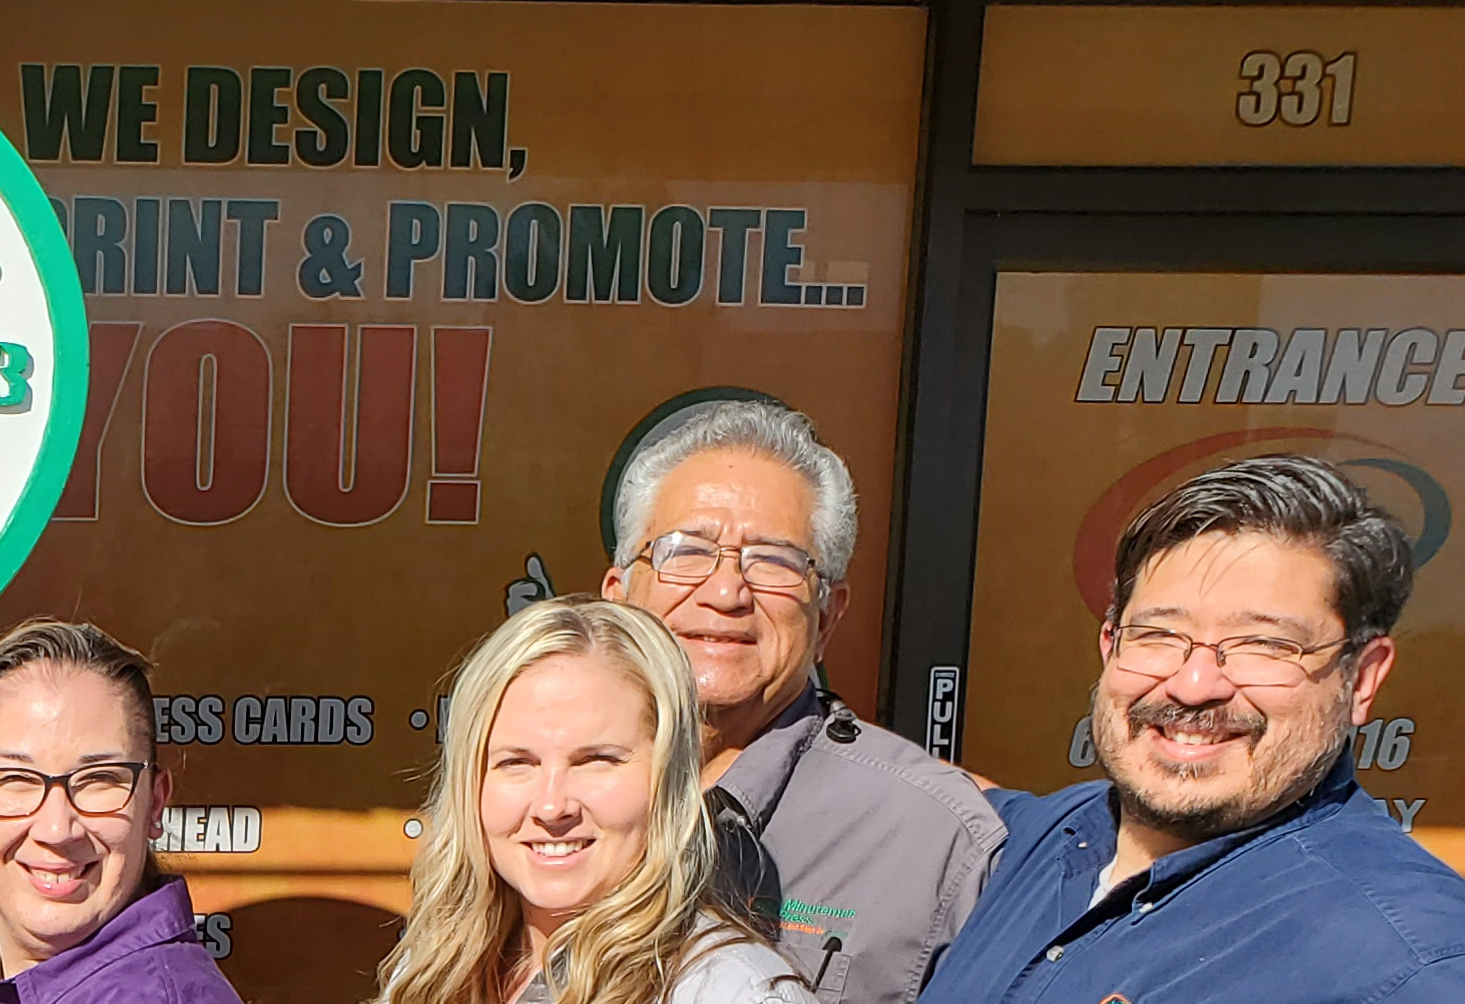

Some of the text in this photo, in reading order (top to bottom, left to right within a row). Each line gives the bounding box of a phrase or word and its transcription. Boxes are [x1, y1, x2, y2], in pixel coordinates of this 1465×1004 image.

[20, 63, 530, 183] WE DESIGN,
[1235, 50, 1358, 128] 331
[297, 213, 365, 300] &
[384, 201, 867, 308] PROMOTE...
[1074, 326, 1465, 406] ENTRANCE
[232, 695, 375, 745] CARDS
[156, 805, 263, 853] HEAD
[1372, 798, 1427, 834] Y
